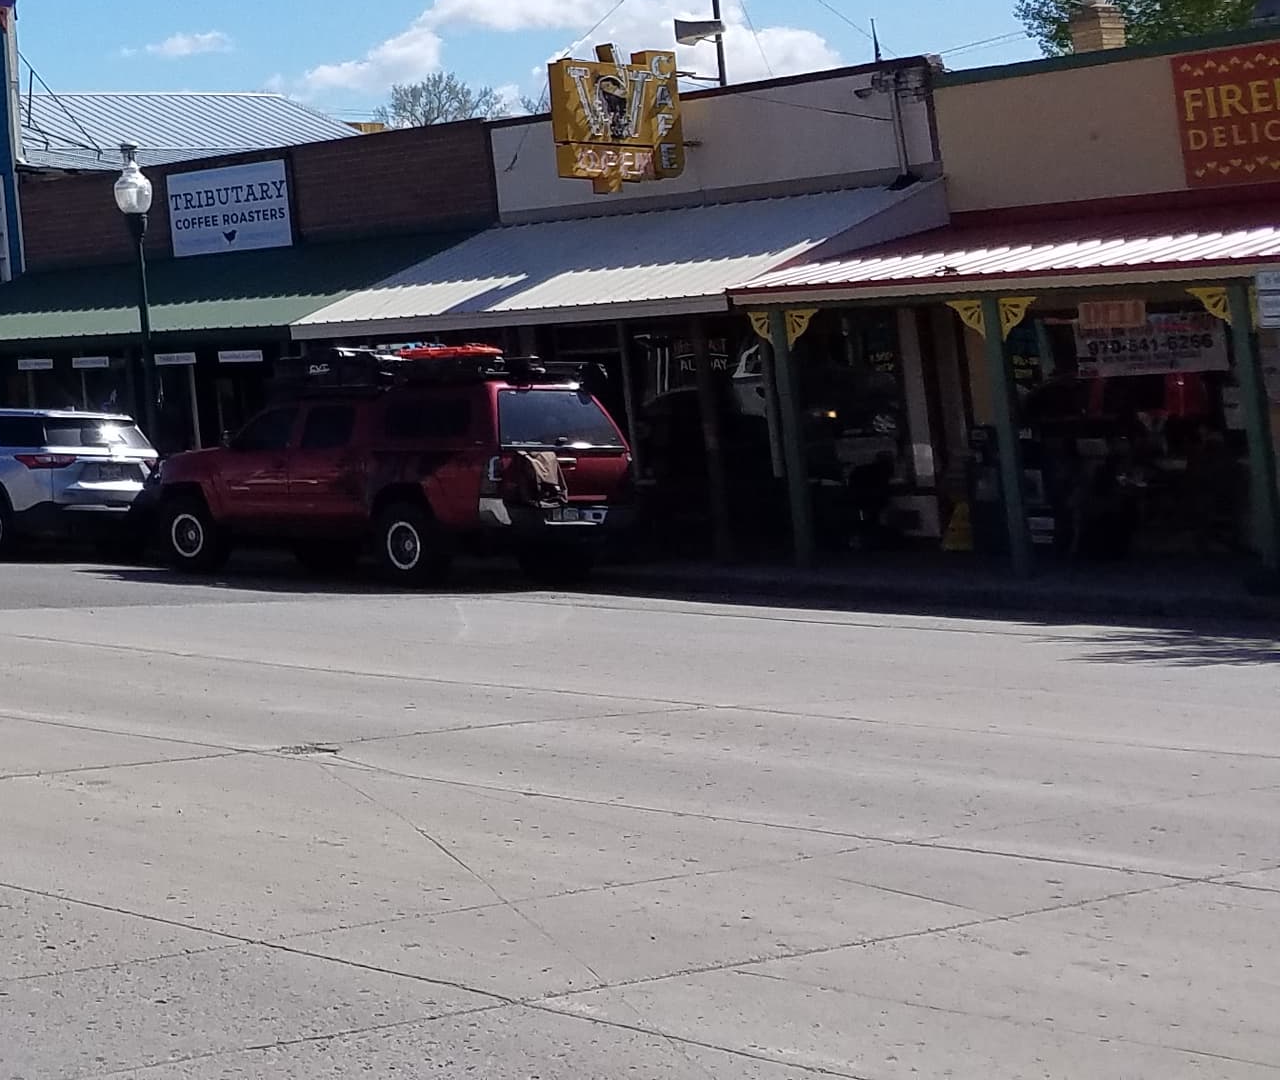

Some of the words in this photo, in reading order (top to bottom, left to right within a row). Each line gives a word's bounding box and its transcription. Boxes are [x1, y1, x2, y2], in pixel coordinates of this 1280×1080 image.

[650, 55, 678, 169] CAFE
[577, 149, 654, 178] OPEN
[170, 180, 286, 211] TRIBUTARY
[175, 215, 219, 231] COFFEE
[222, 207, 286, 226] ROASTERS
